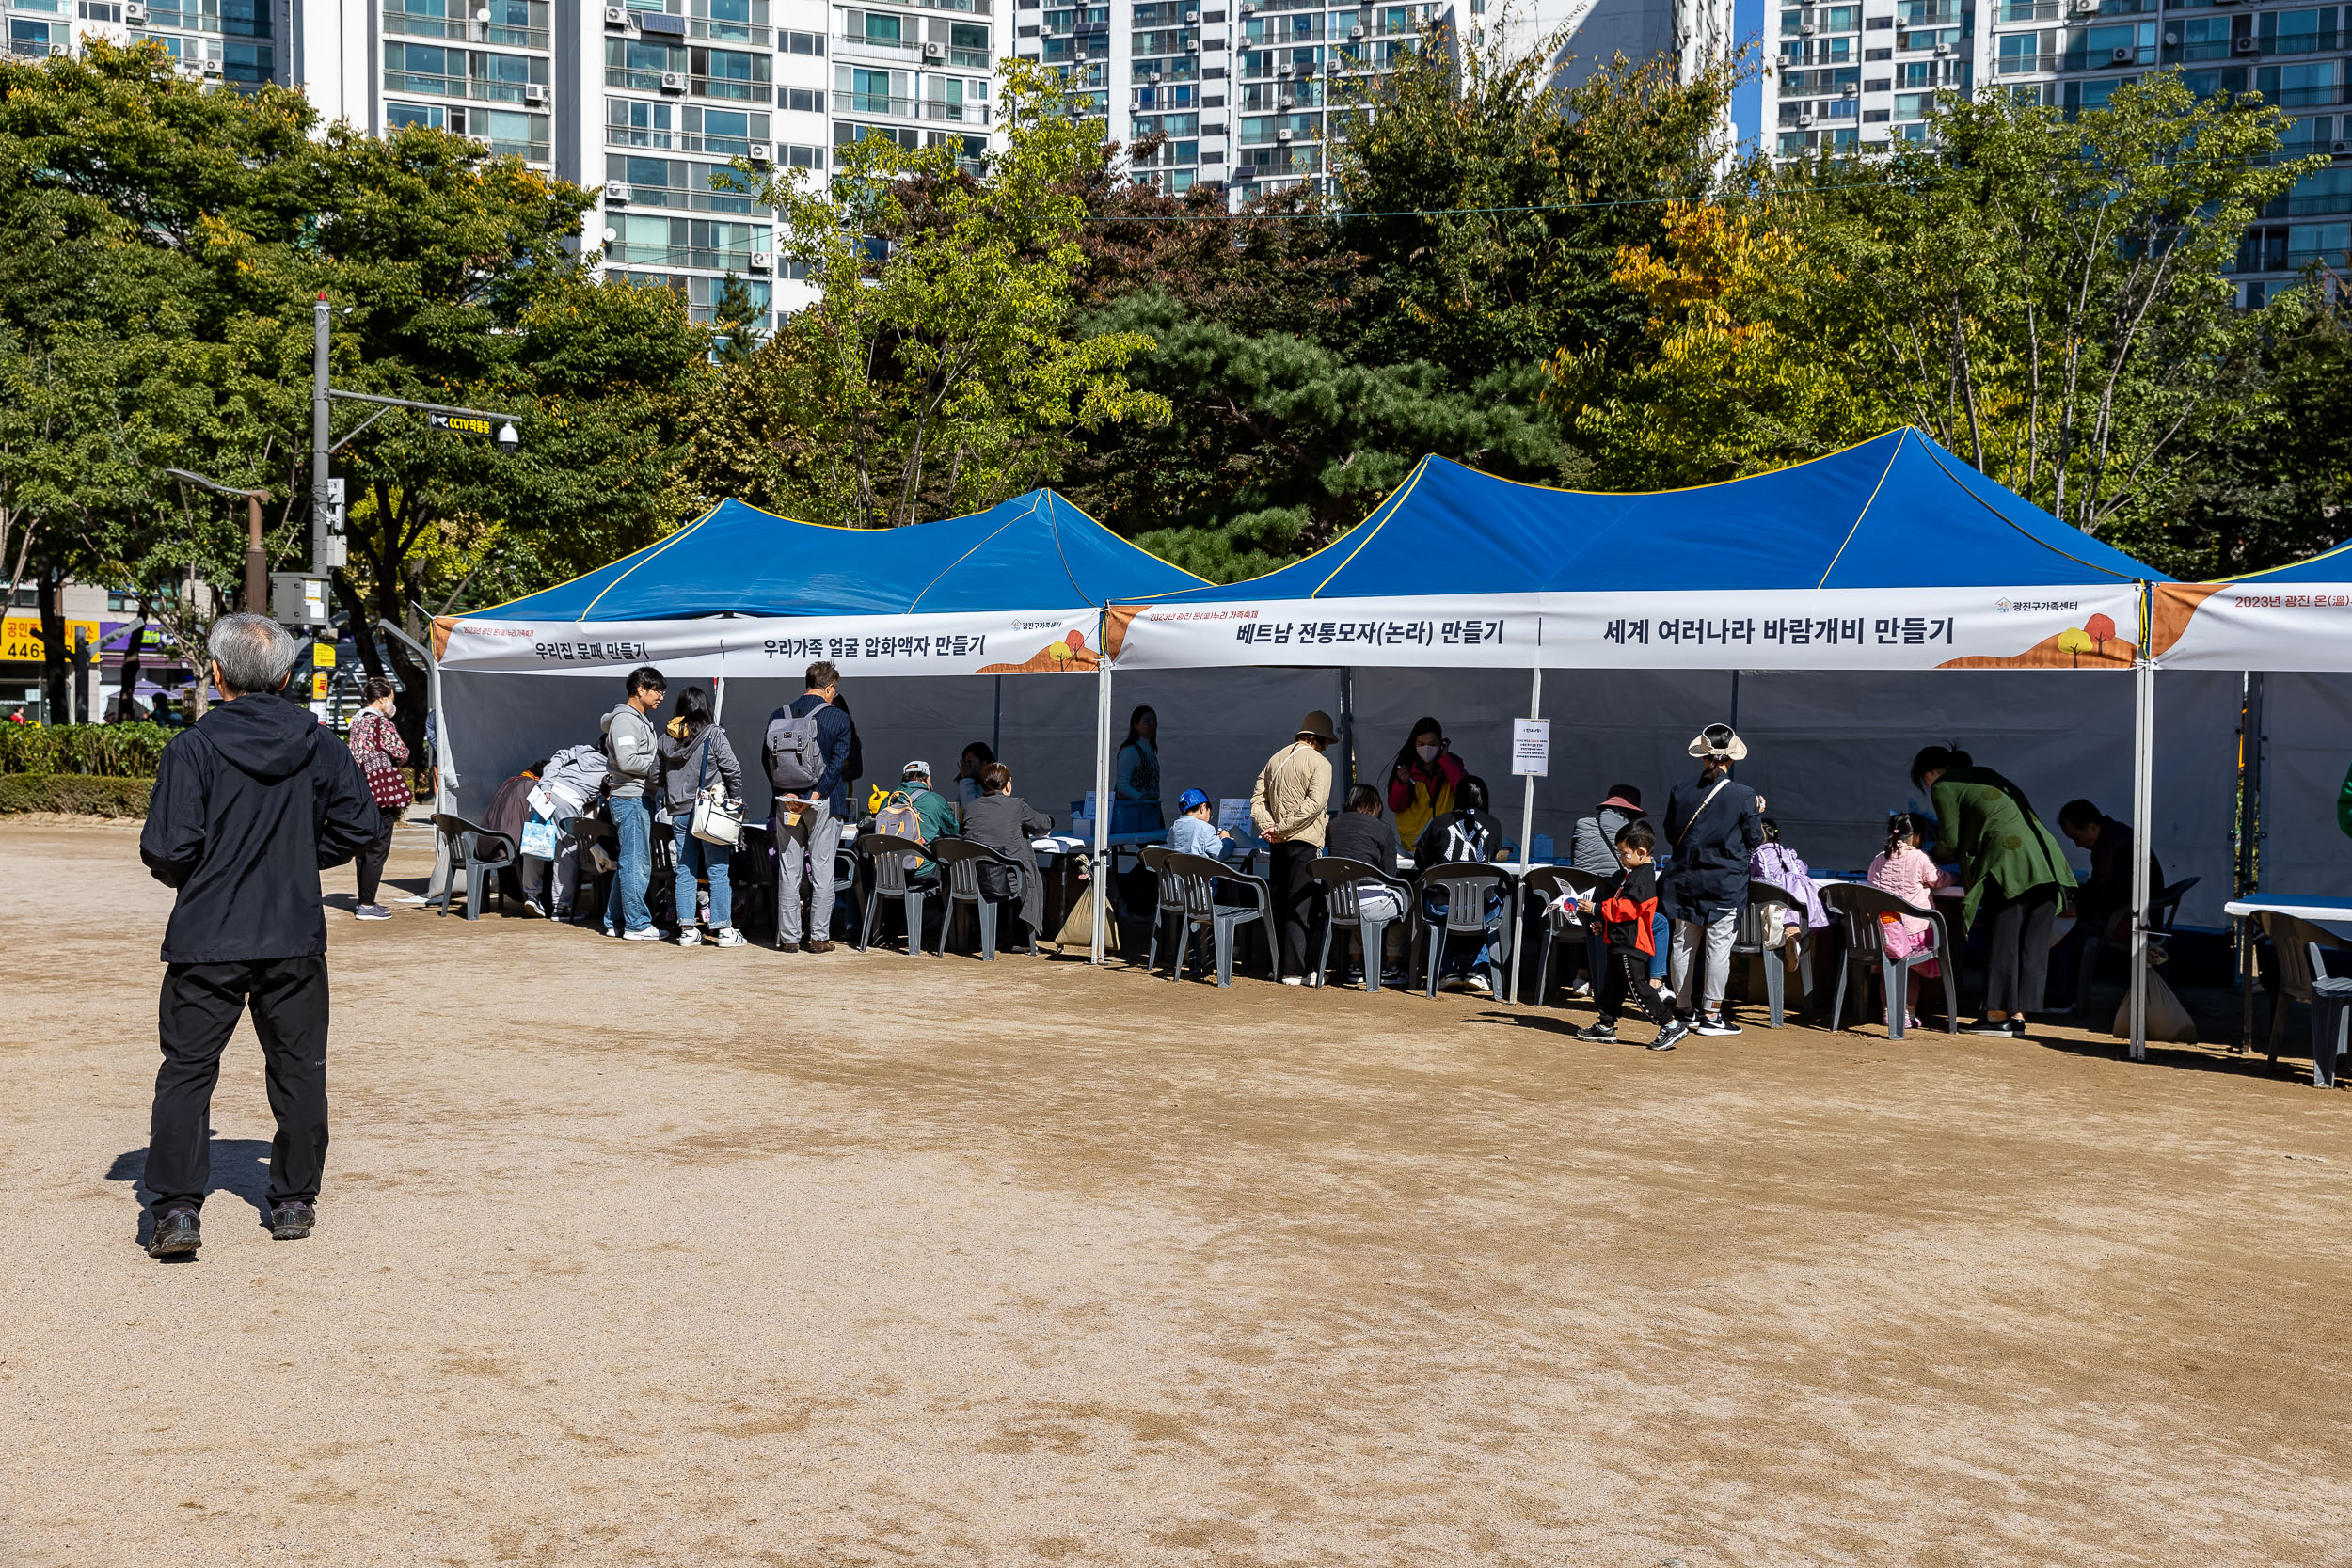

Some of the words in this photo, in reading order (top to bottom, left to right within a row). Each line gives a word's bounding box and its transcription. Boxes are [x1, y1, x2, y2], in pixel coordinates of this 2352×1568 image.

[449, 418, 469, 430] CCTV
[2013, 601, 2078, 611] 광진구가족센터
[2235, 596, 2281, 608] 2023년
[2285, 595, 2310, 608] 광진
[2314, 595, 2352, 608] 온(溫)
[1150, 612, 1176, 622] 2023년
[1176, 612, 1193, 621] 광진
[1229, 610, 1259, 619] 가족축제
[1236, 623, 1293, 644] 베트남
[1298, 621, 1434, 646] 전통모자(논라)
[1440, 620, 1504, 644] 만들기
[1603, 618, 1649, 644] 세계
[1658, 618, 1756, 644] 여러나라
[1763, 617, 1865, 645] 바람개비
[1875, 617, 1954, 645] 만들기
[535, 642, 573, 660] 우리집
[577, 642, 605, 660] 문패
[607, 641, 650, 660] 만들기
[764, 638, 823, 658] 우리가족
[828, 637, 860, 658] 얼굴
[865, 635, 930, 657] 압화액자
[935, 634, 986, 656] 만들기
